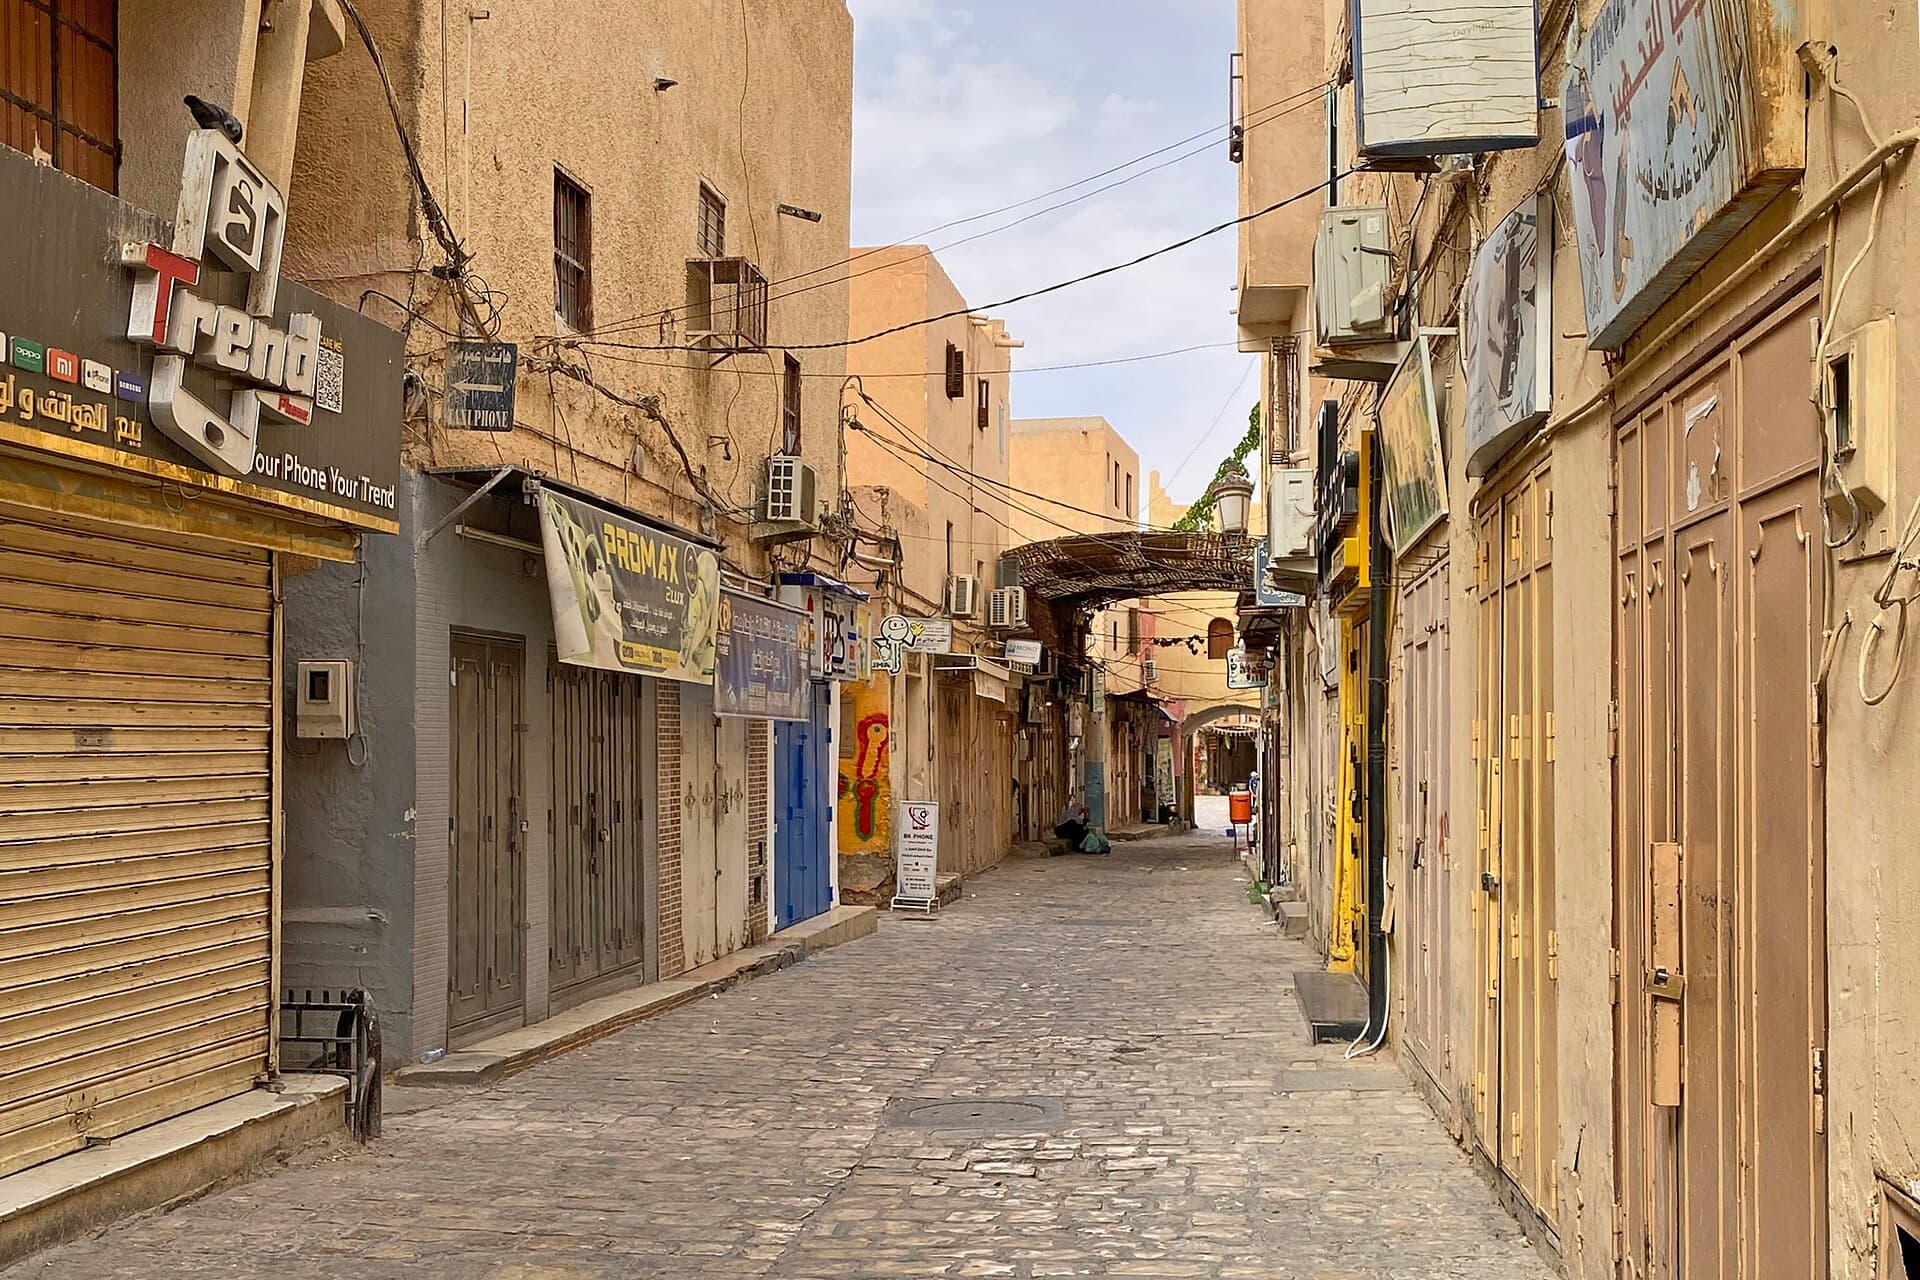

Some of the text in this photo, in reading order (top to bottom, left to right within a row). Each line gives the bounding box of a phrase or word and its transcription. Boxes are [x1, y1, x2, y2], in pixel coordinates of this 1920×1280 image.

[144, 243, 323, 399] Trend
[119, 380, 142, 393] SAMSUNG
[37, 390, 108, 433] الهواتف
[278, 393, 309, 422] Phone
[474, 409, 510, 428] PHONE
[115, 416, 142, 448] بيع
[254, 443, 395, 510] our Phone Your Trend
[603, 522, 679, 586] PROMAX
[912, 833, 933, 841] PHONE
